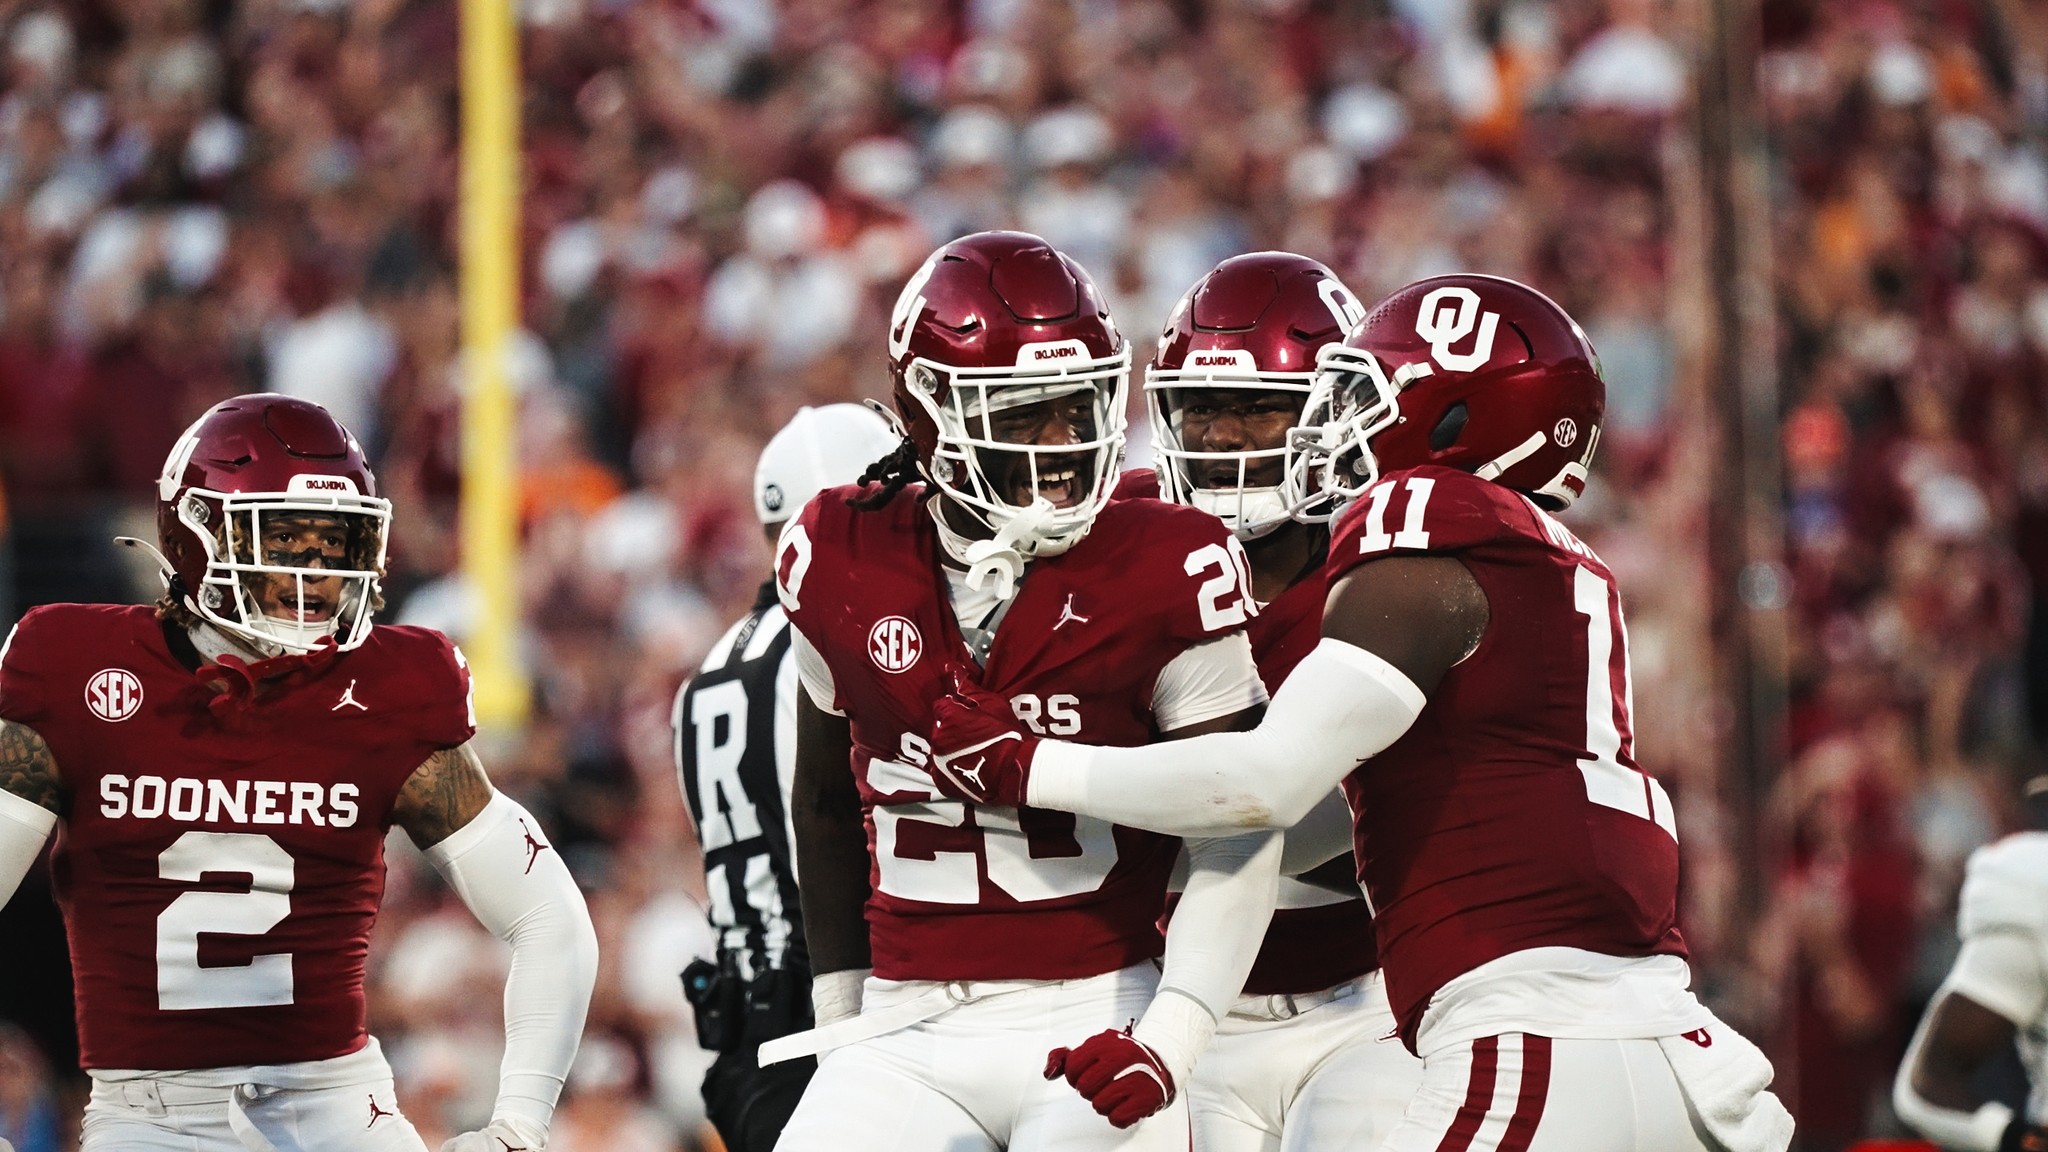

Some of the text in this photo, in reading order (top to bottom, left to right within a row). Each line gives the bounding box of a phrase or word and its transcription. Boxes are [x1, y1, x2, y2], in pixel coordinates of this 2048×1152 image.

[1034, 346, 1078, 360] OKLAHOMA
[1415, 287, 1500, 372] OU
[1195, 356, 1237, 366] OKLAHOMA
[1555, 419, 1577, 446] SEC
[306, 480, 347, 491] OKLAHOMA
[1359, 477, 1436, 555] 11
[1183, 533, 1260, 632] 20
[872, 619, 918, 669] SEC
[91, 671, 139, 719] SEC
[691, 678, 763, 854] R
[100, 774, 359, 828] SOONERS
[866, 757, 1119, 904] 20
[156, 831, 295, 1011] 2
